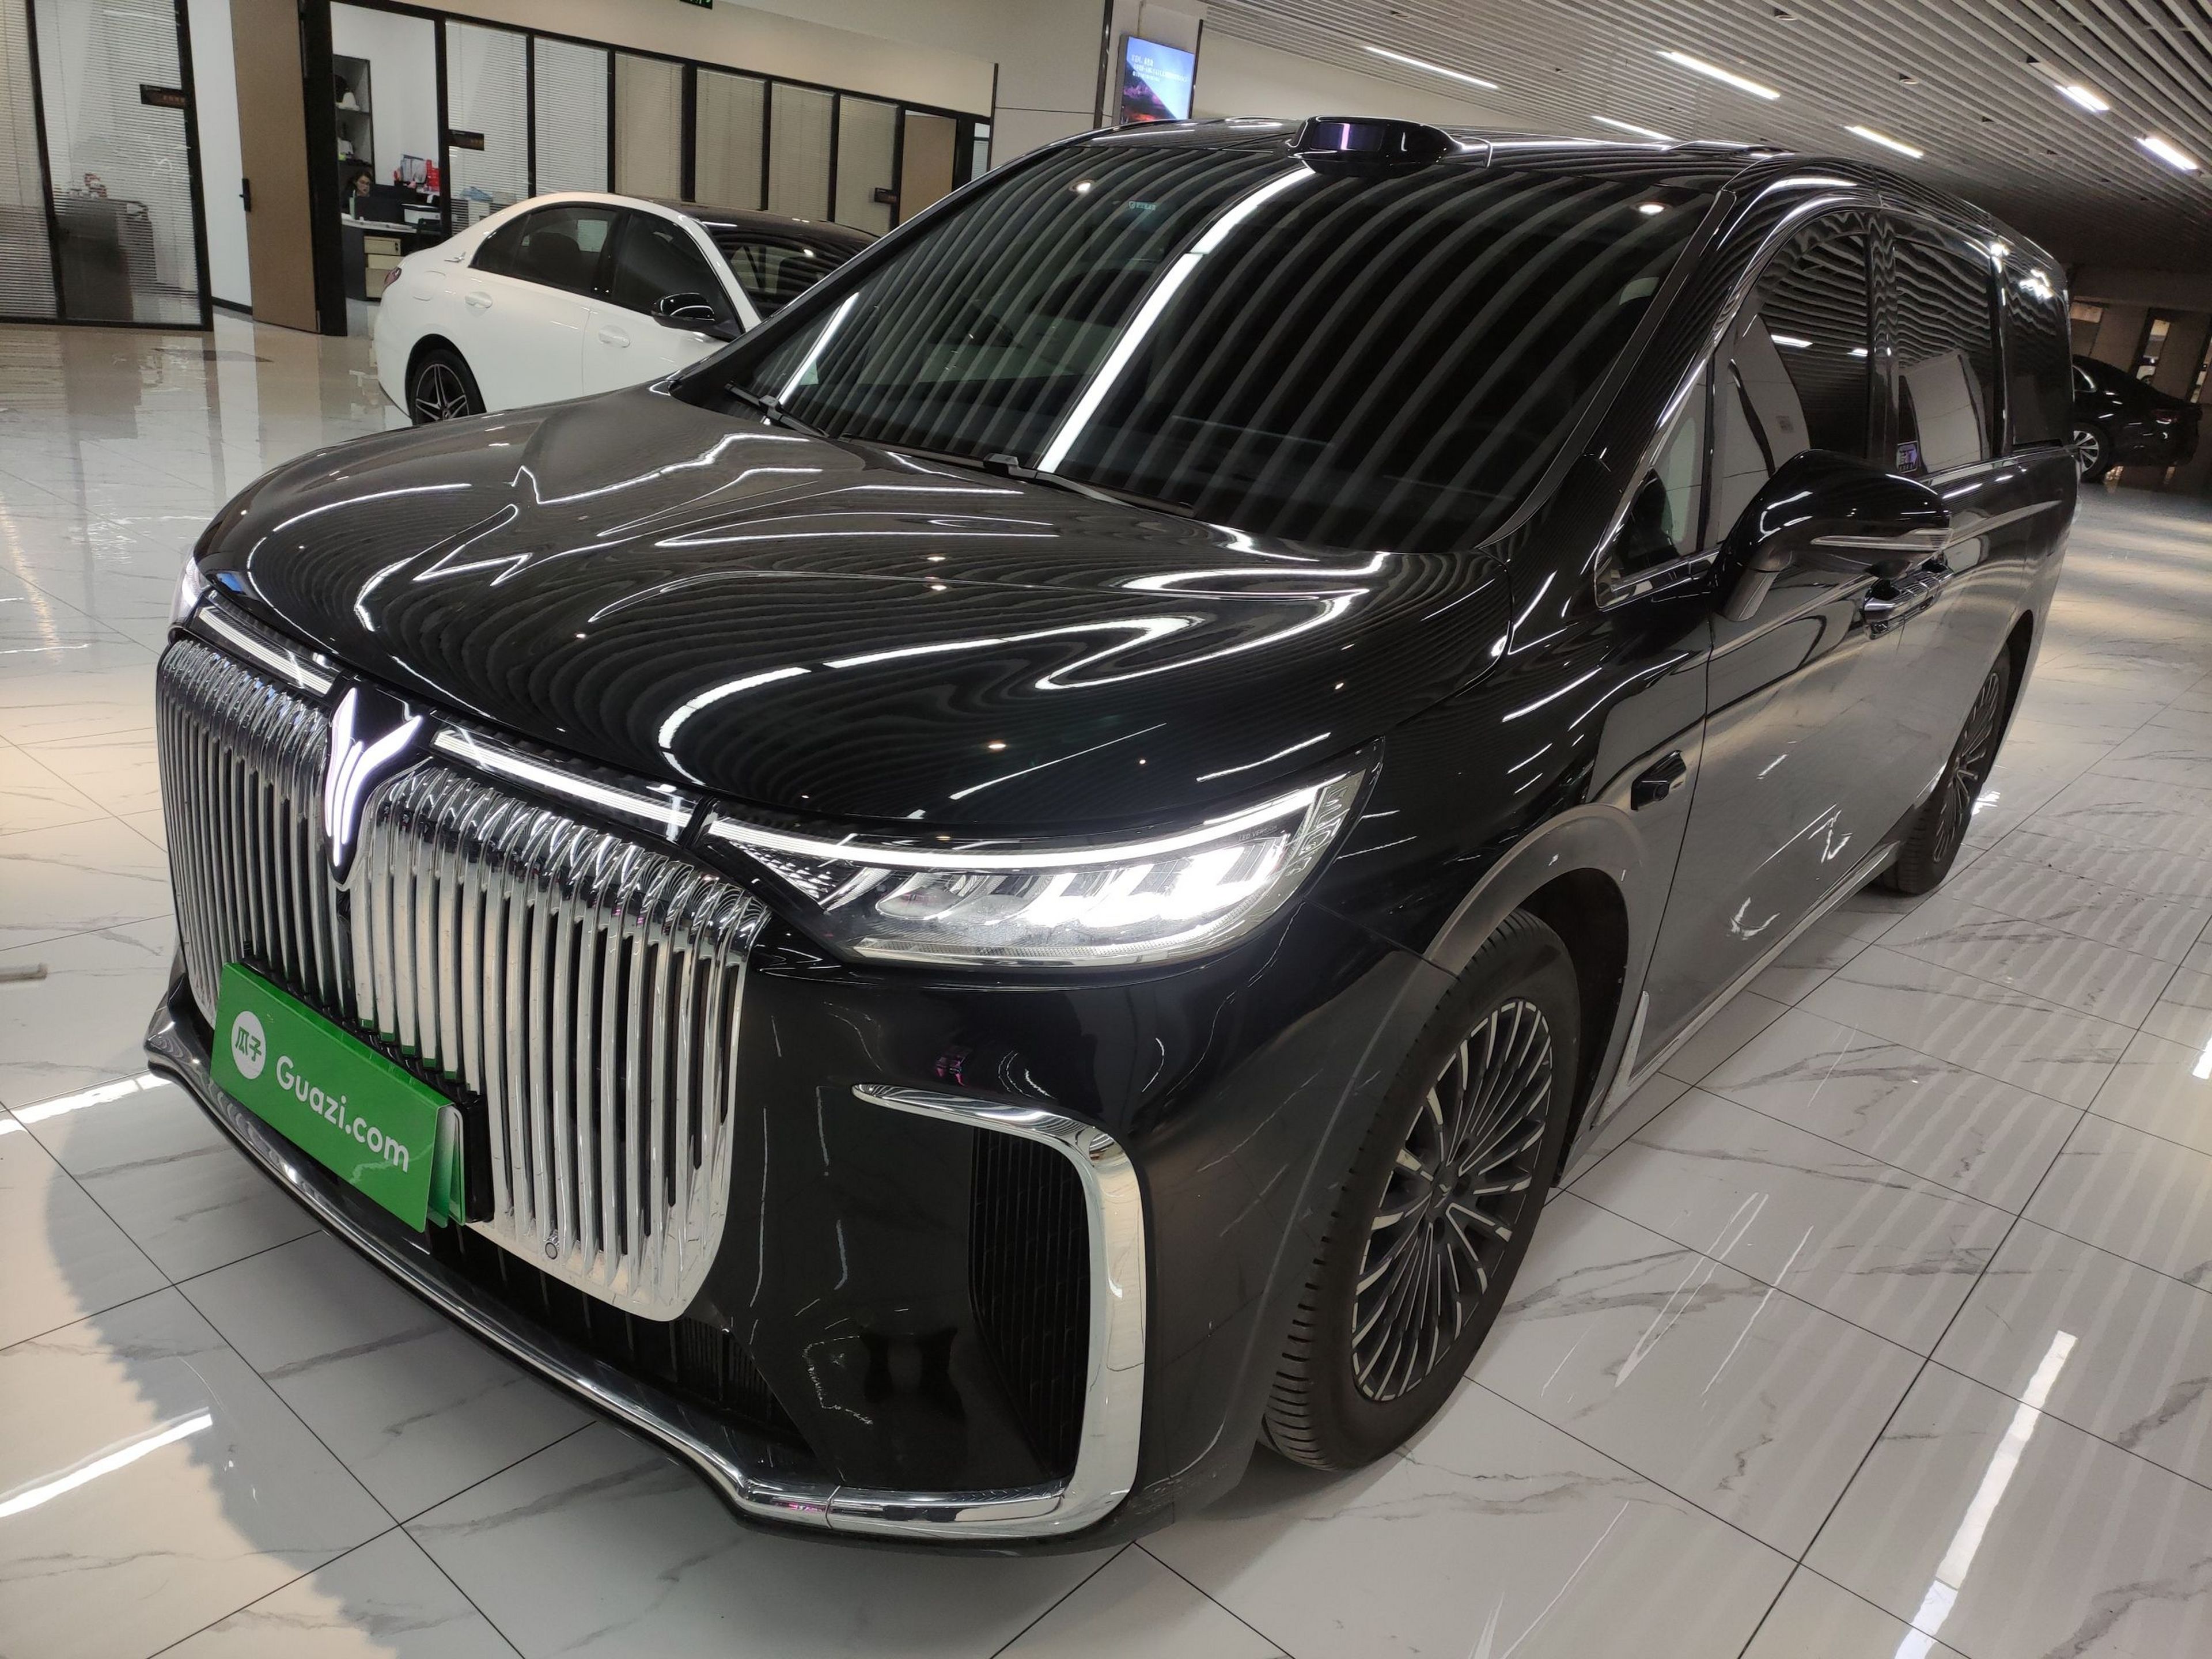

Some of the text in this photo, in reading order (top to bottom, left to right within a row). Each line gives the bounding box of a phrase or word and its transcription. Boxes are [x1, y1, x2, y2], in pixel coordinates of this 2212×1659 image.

[1238, 833, 1251, 841] LED
[235, 1027, 262, 1062] 瓜子
[276, 1055, 409, 1172] Guazi.com
